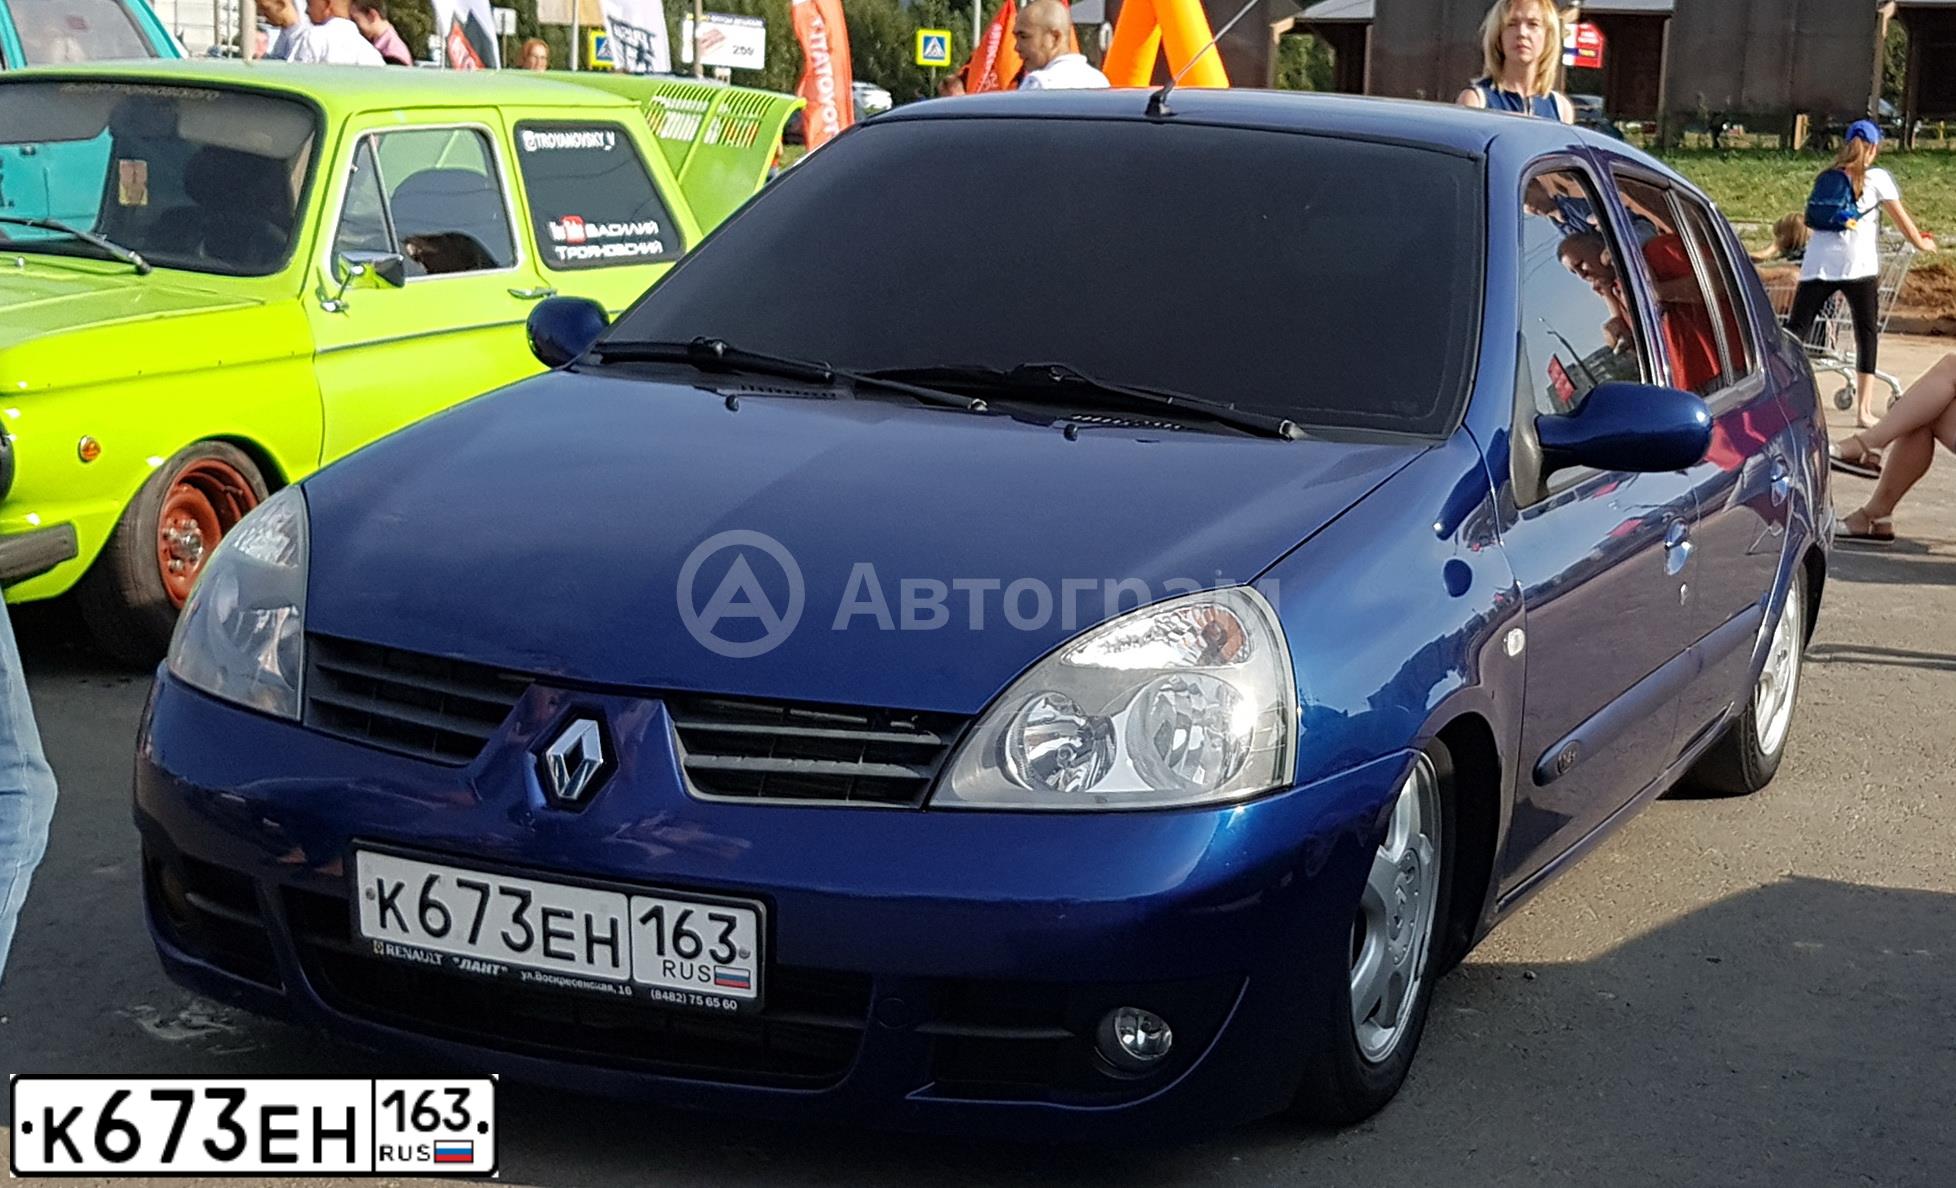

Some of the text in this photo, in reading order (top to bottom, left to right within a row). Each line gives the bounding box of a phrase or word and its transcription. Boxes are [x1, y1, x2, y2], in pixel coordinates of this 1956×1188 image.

[555, 240, 664, 260] ТРОЯНОВСКИЙ
[586, 220, 659, 238] ВАСИЛИЙ
[376, 873, 620, 969] К673ЕН
[638, 905, 738, 965] 163
[385, 943, 444, 966] RENAULT
[650, 988, 687, 1004] (8482)
[688, 994, 703, 1006] 75
[705, 996, 720, 1008] 65
[722, 998, 737, 1010] 60
[662, 959, 711, 983] RUS
